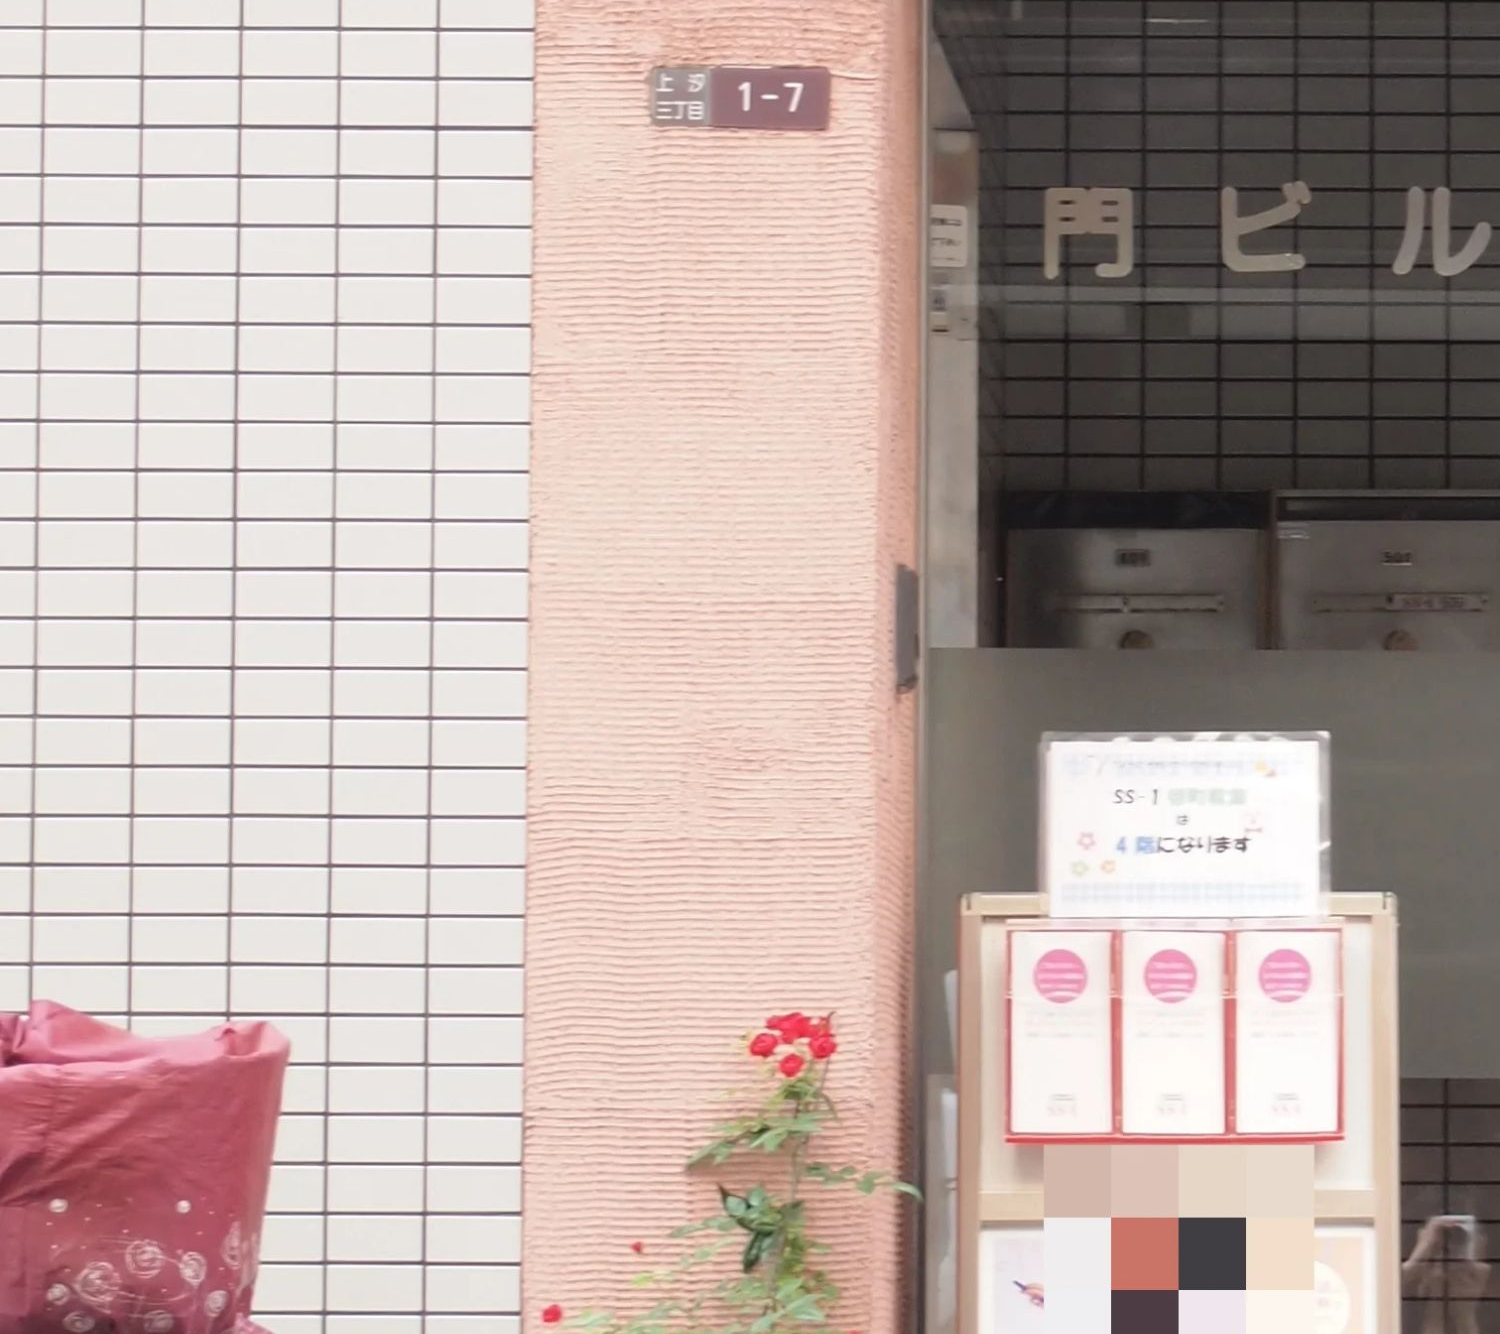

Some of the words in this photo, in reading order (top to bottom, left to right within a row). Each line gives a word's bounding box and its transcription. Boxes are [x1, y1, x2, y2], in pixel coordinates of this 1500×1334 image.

[737, 81, 804, 113] 1-7
[655, 100, 705, 121] 三丁目
